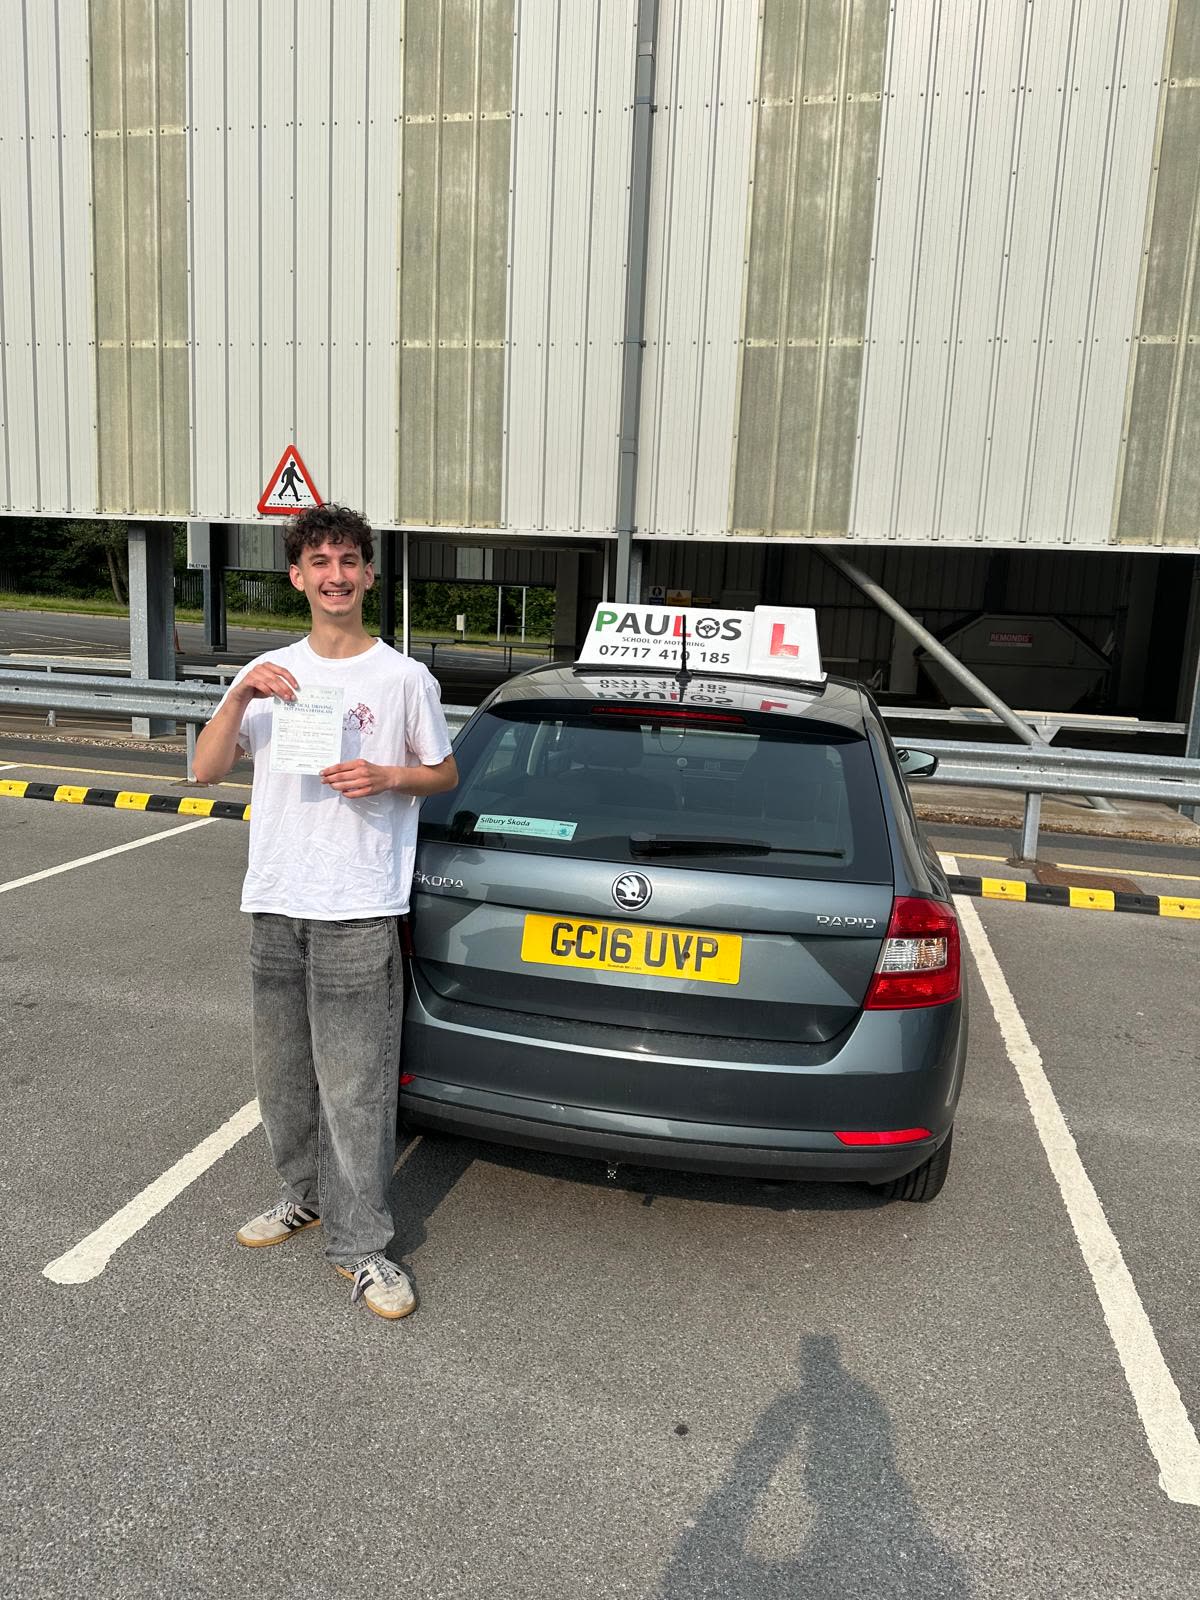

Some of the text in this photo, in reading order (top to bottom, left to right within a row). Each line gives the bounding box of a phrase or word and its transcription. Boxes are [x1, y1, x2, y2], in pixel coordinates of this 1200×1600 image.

[595, 610, 742, 641] PAULOS
[622, 636, 650, 644] SCHOOL
[769, 623, 800, 657] L
[599, 644, 651, 659] 07717
[700, 652, 730, 664] 185
[480, 816, 506, 825] Silbury
[816, 915, 877, 929] RAPID
[550, 921, 719, 973] GC16 UVP
